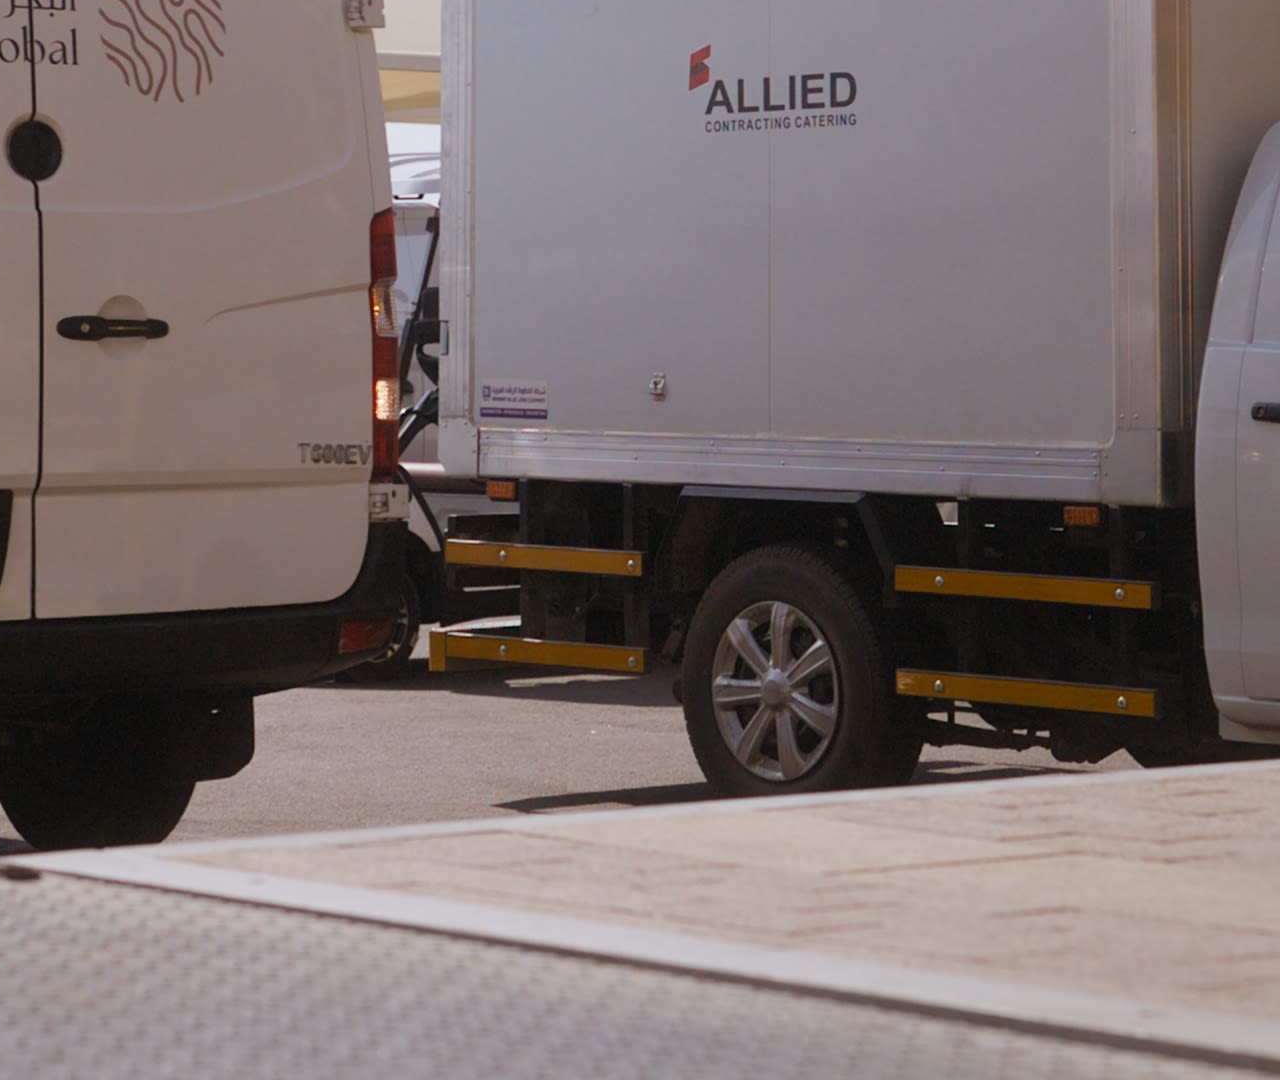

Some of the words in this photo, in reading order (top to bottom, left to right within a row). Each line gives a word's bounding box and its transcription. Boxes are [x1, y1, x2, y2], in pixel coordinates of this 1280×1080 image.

[705, 72, 857, 115] ALLIED
[705, 117, 791, 133] CONTRACTING
[795, 114, 857, 129] CATERING
